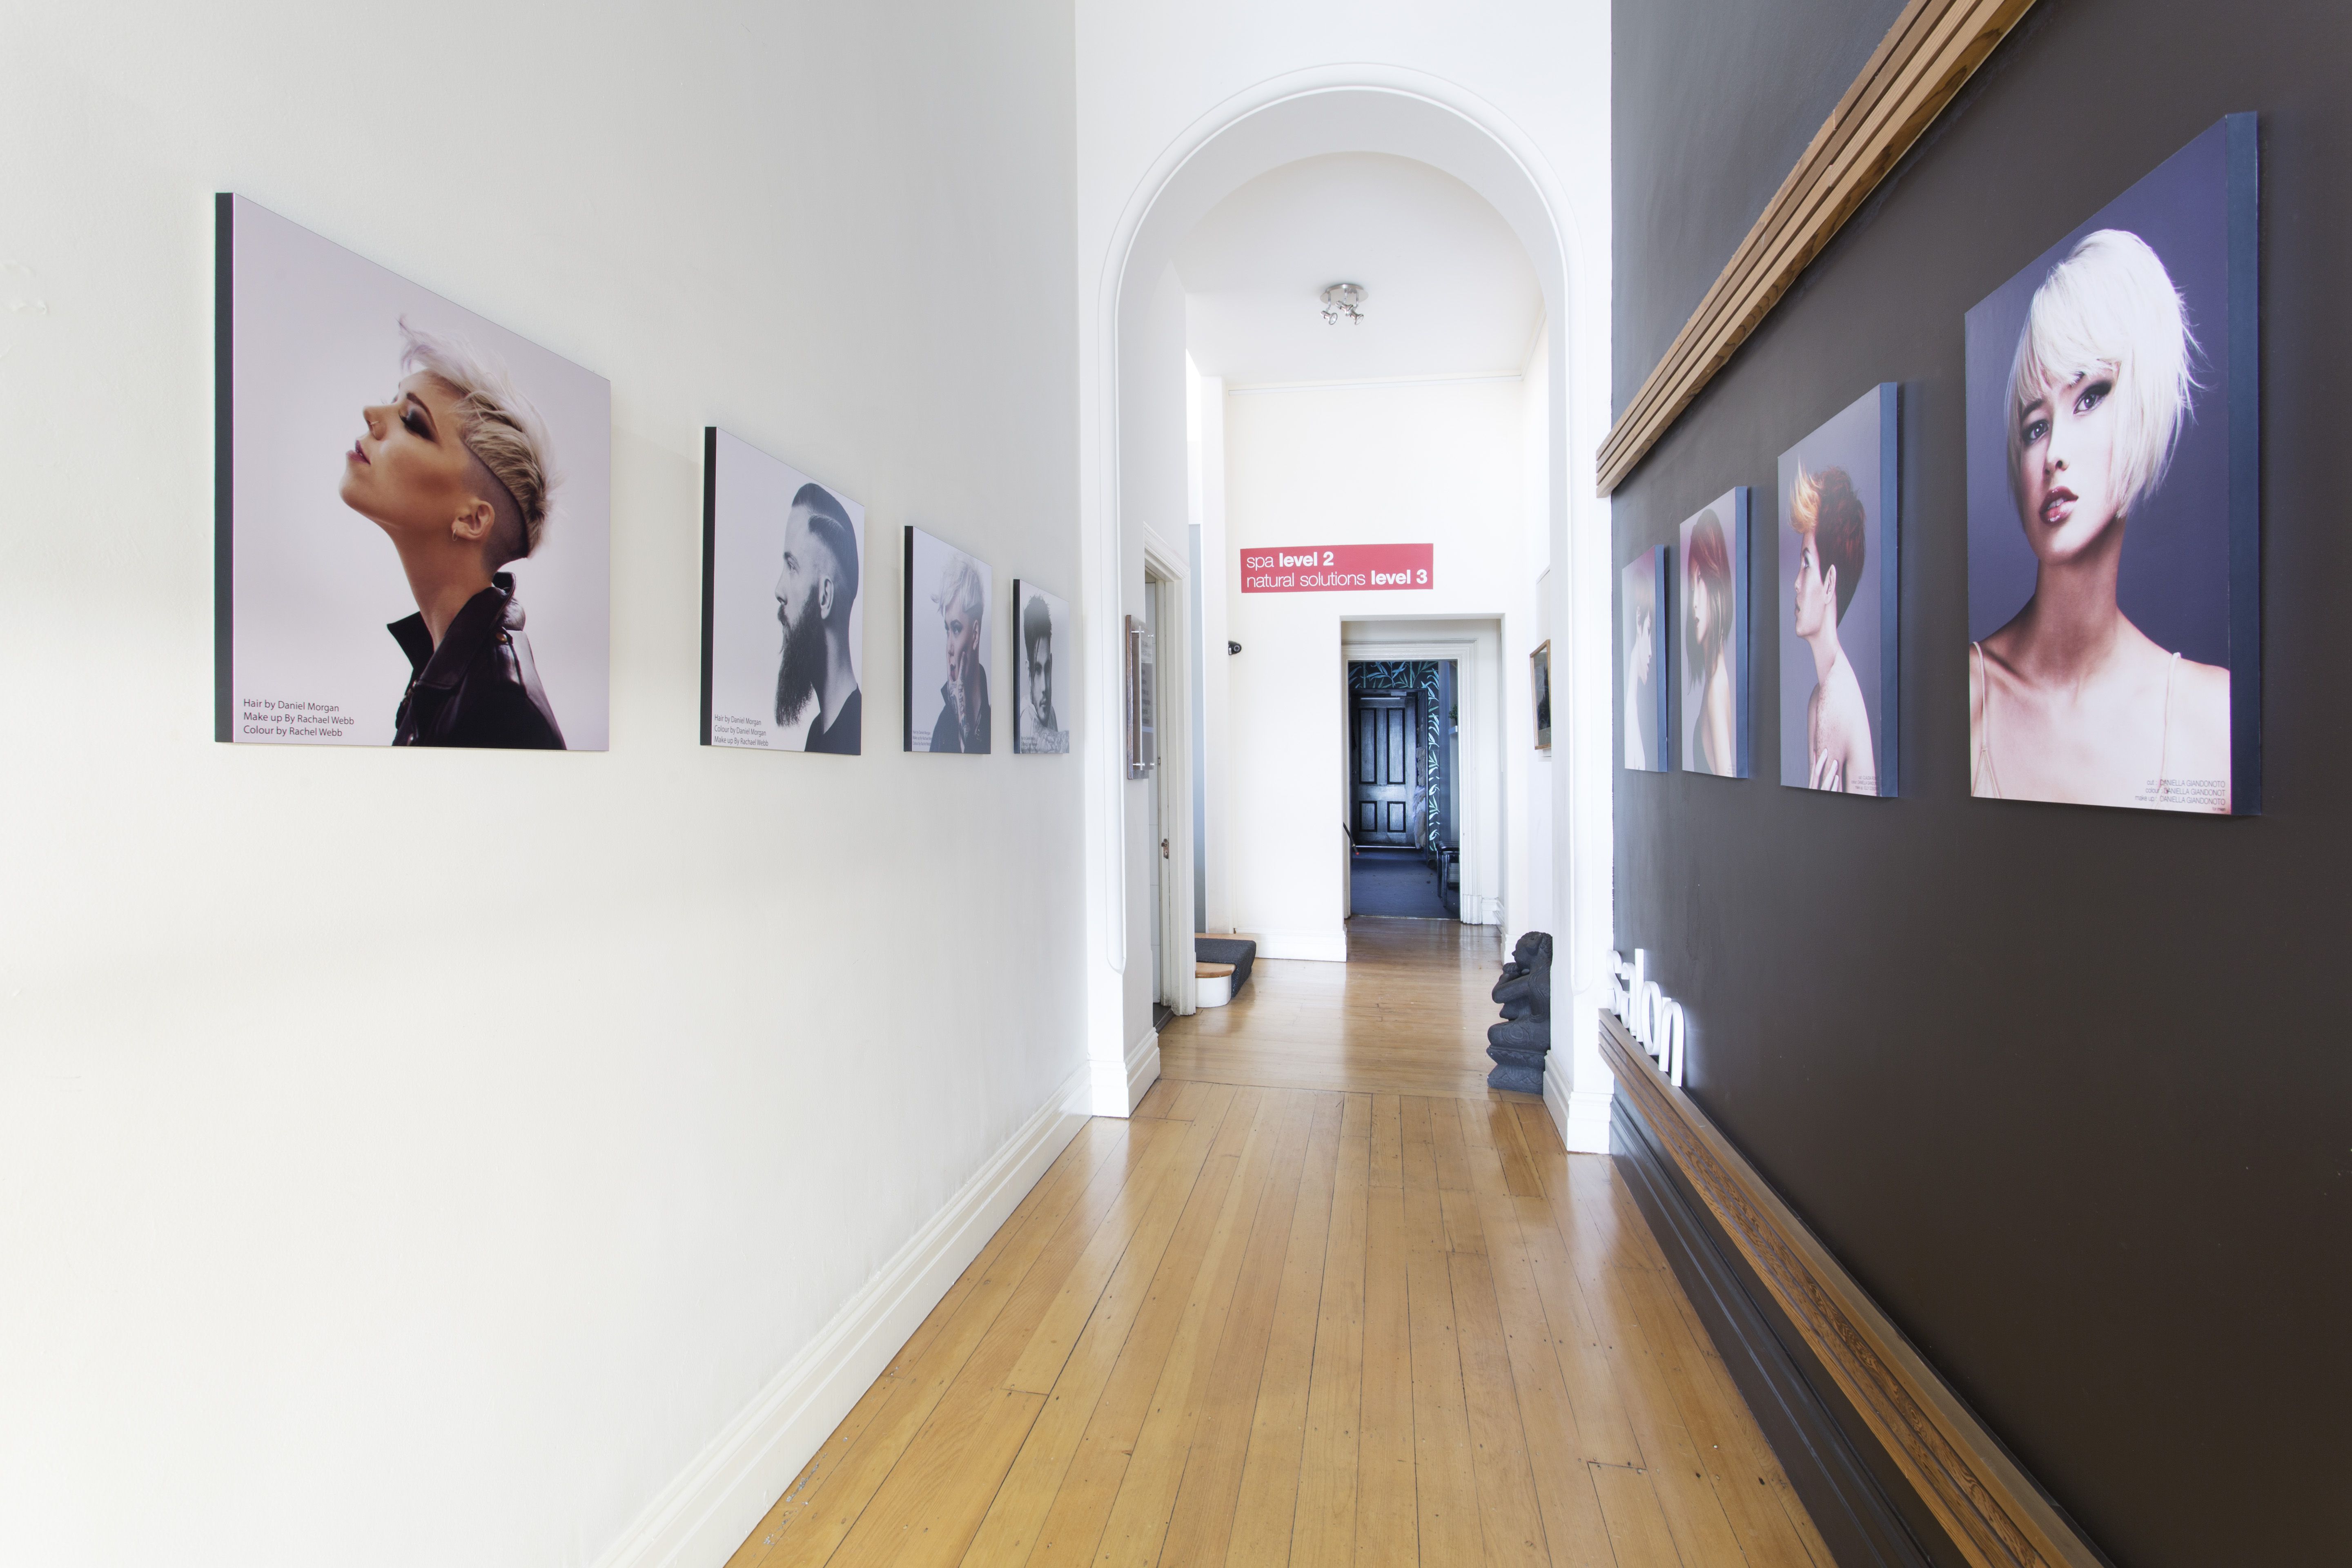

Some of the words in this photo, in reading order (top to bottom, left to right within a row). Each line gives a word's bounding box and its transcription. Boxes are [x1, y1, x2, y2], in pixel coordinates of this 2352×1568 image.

[1246, 556, 1274, 571] spa
[1279, 552, 1318, 567] level
[1323, 551, 1334, 566] 2
[1246, 572, 1295, 588] natural
[1300, 571, 1365, 587] solutions
[1371, 569, 1411, 585] level
[1416, 569, 1428, 584] 3
[243, 698, 262, 708] Hair
[265, 699, 276, 710] by
[278, 701, 305, 710] Daniel
[307, 702, 339, 713] Morgan
[243, 712, 268, 722] Make
[270, 715, 283, 723] up
[285, 714, 295, 724] By
[298, 715, 330, 724] Rachael
[331, 717, 354, 725] Webb
[725, 715, 731, 724] by
[731, 716, 745, 724] Daniel
[746, 718, 762, 727] Morgan
[243, 725, 274, 735] Colour
[276, 726, 287, 737] by
[290, 727, 317, 736] Rachel
[318, 728, 343, 737] Webb
[730, 726, 735, 735] by
[751, 728, 766, 737] Morgan
[735, 737, 739, 746] By
[2186, 780, 2225, 788] GIANDONOTO
[2186, 797, 2225, 806] GIANDONOTO
